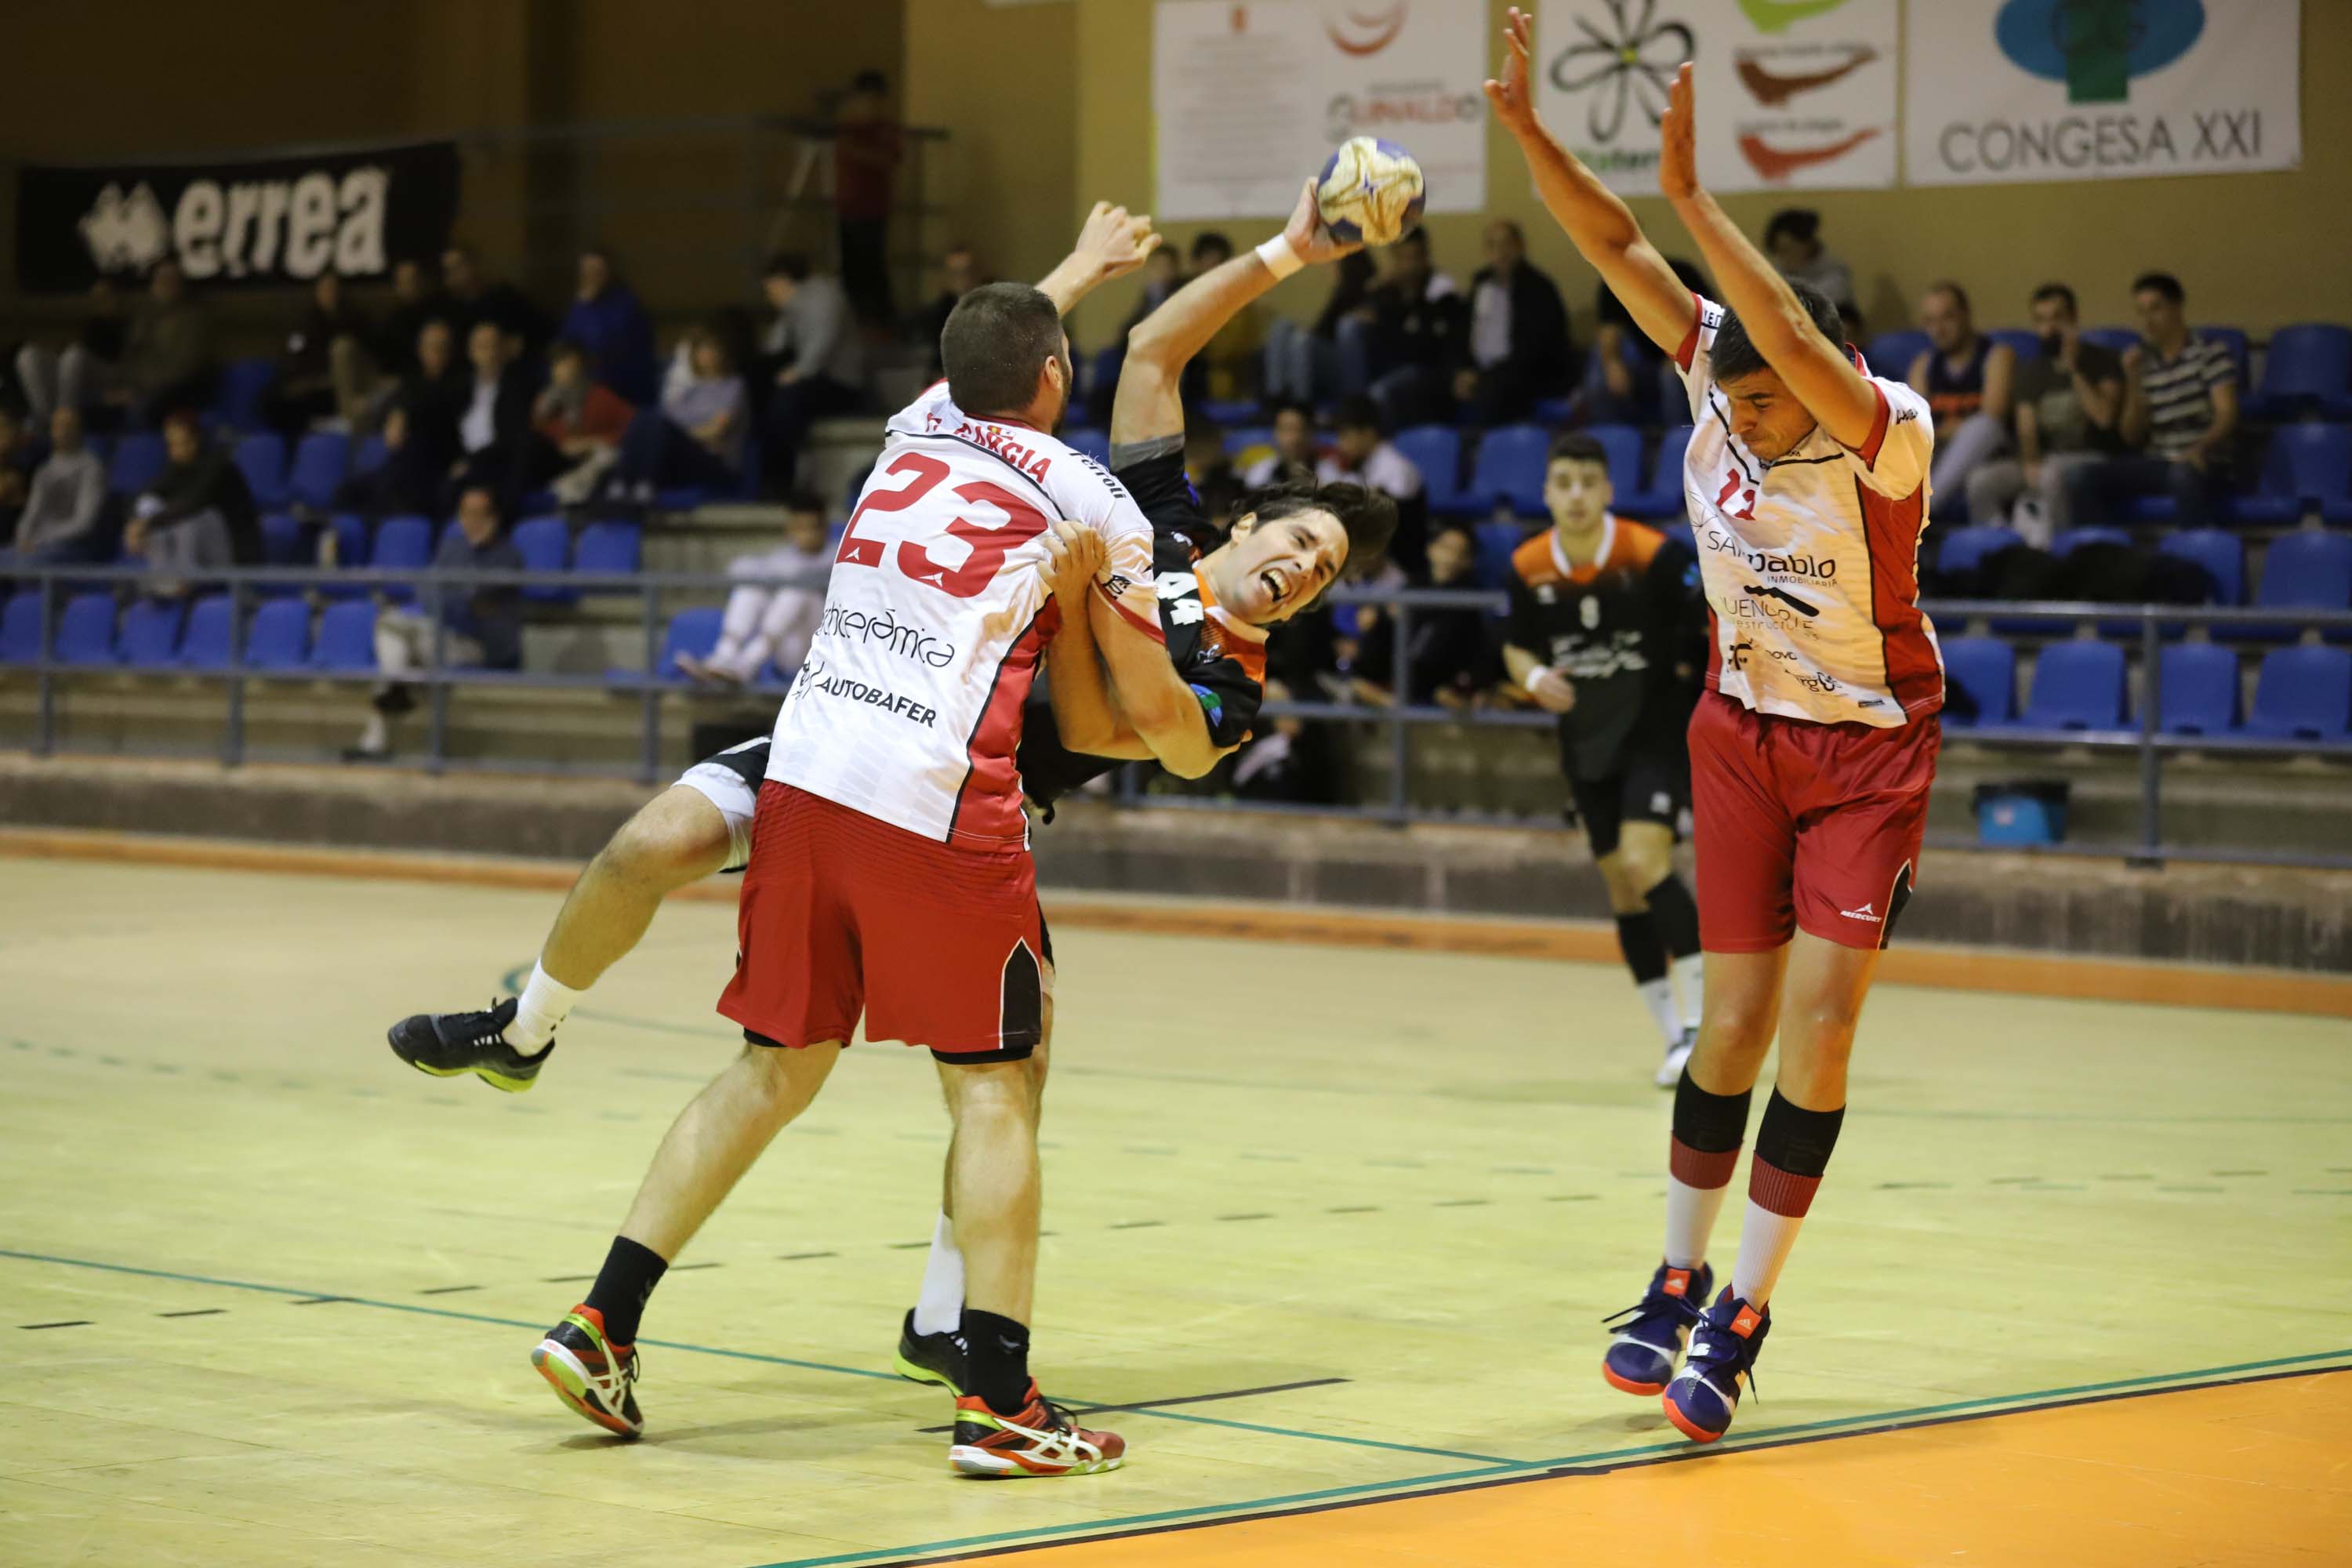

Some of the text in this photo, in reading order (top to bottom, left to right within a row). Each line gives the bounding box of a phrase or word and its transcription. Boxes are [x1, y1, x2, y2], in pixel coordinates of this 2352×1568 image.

[1940, 111, 2262, 172] CONGESA XXI
[173, 167, 389, 279] errea
[836, 452, 1049, 598] 23
[1707, 530, 1745, 558] SA
[1154, 571, 1205, 626] 44
[1767, 575, 1838, 588] INMOBILIARIA
[815, 676, 938, 729] AUTOBAFER
[1839, 910, 1882, 923] MERCURY
